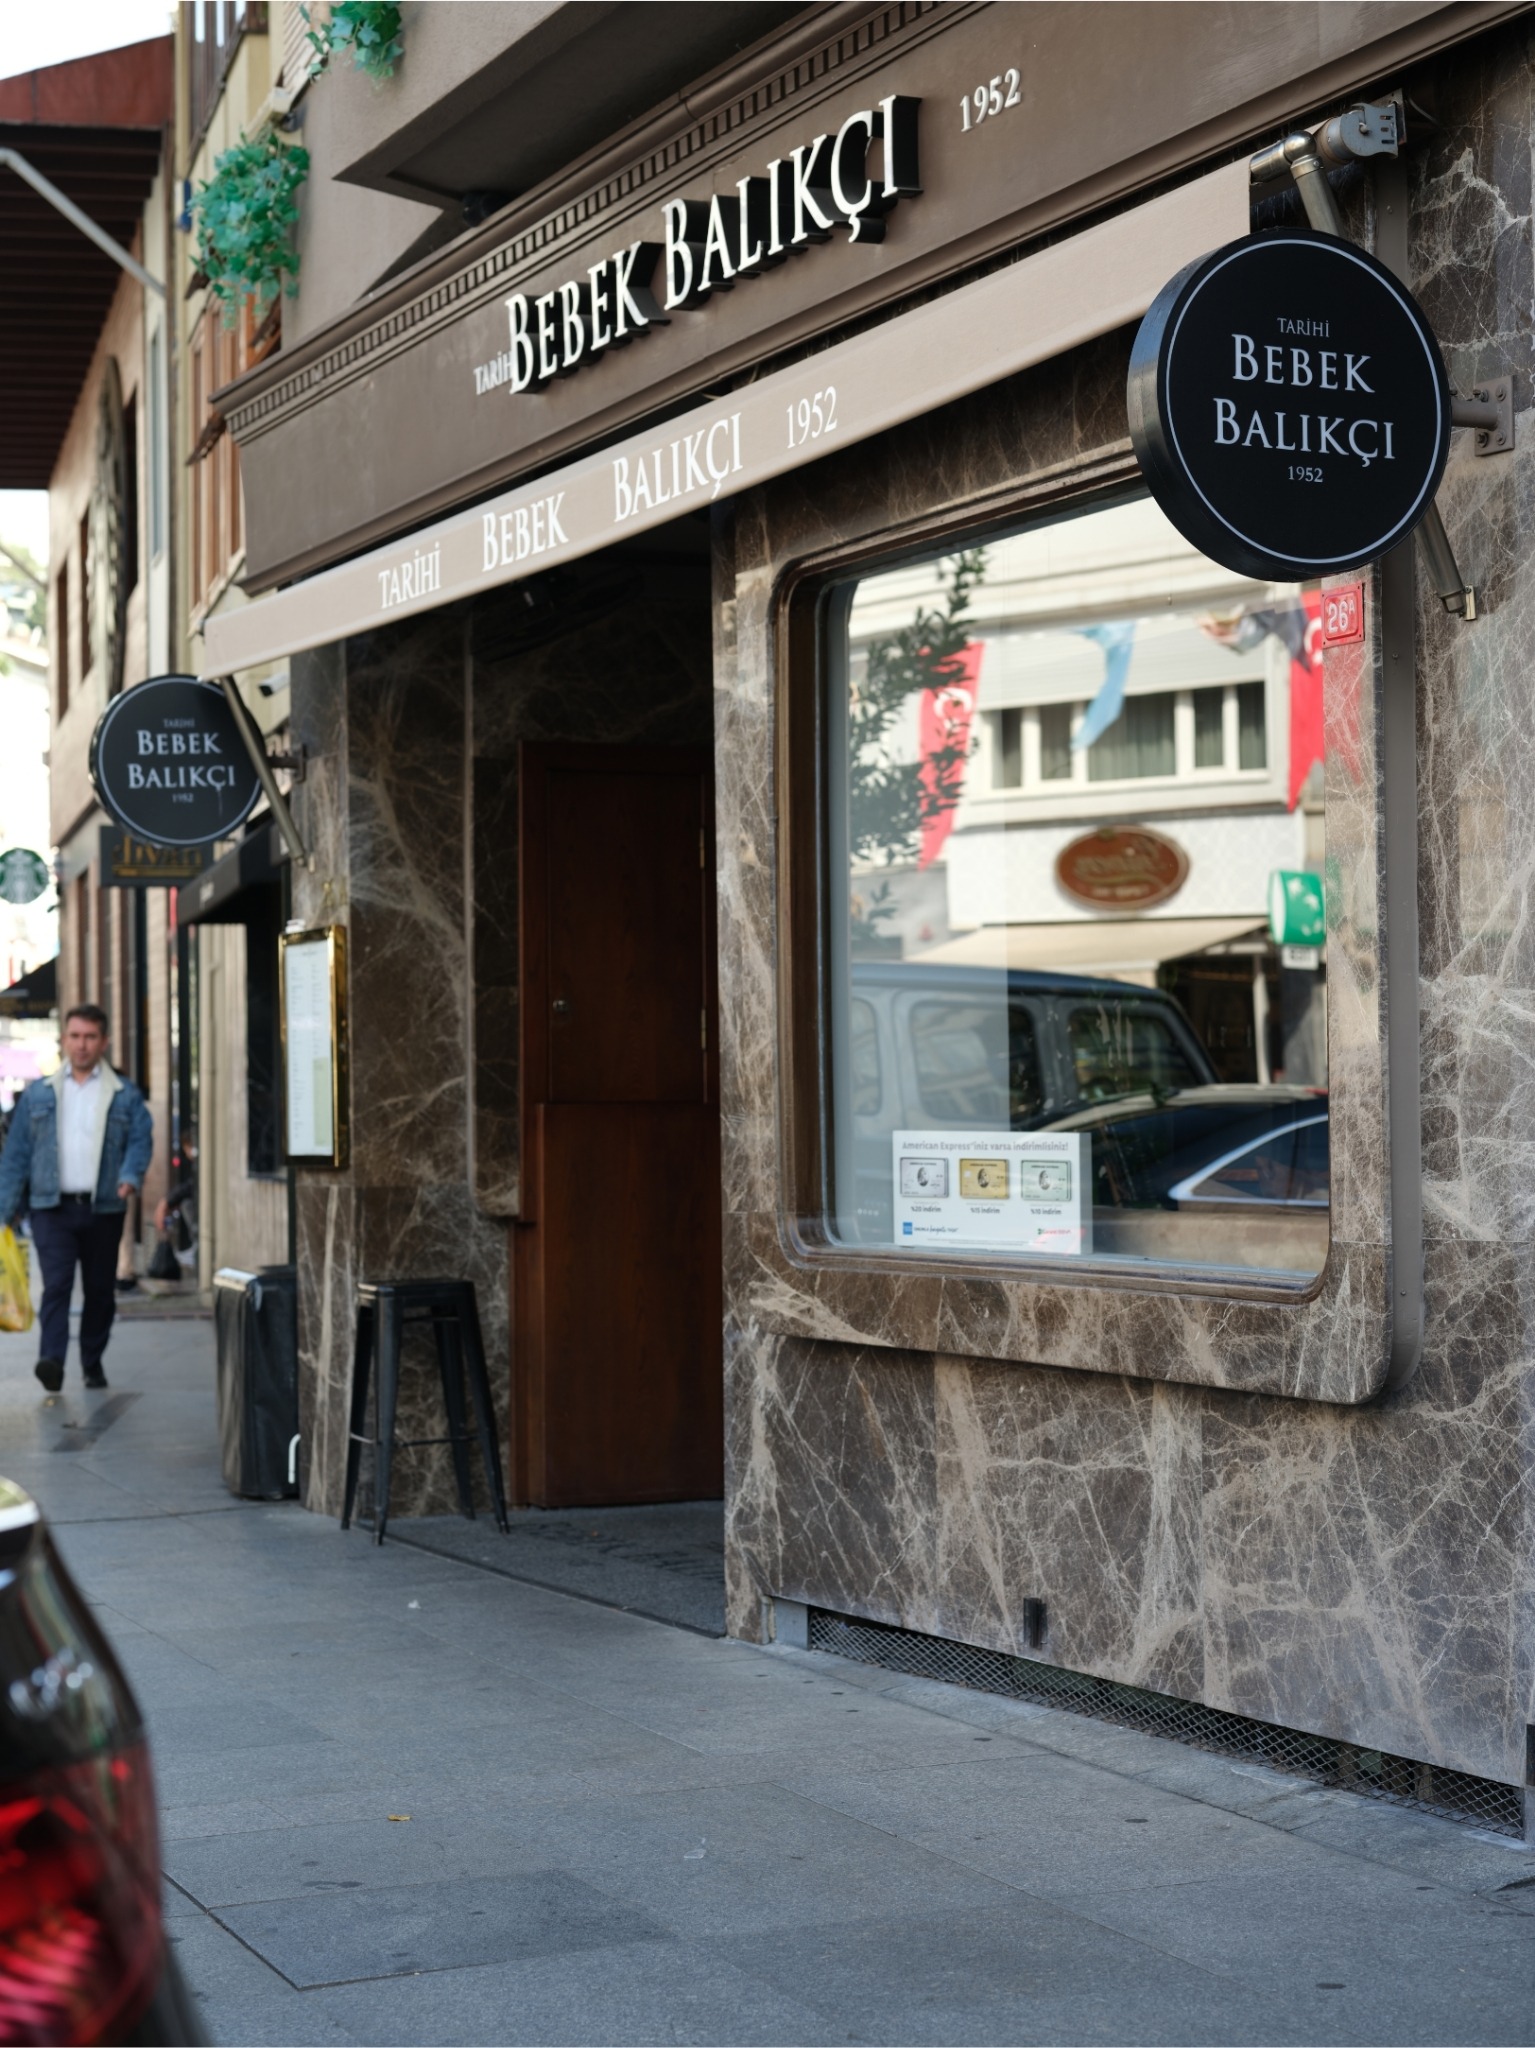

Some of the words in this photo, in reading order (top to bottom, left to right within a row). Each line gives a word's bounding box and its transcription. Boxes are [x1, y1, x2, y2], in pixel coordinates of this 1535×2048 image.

[473, 350, 514, 395] TARİH
[505, 240, 648, 394] BEBEK
[661, 94, 899, 310] BALIKÇI
[959, 68, 1021, 132] 1952
[1277, 317, 1330, 338] TARİHİ
[1231, 333, 1375, 393] BEBEK
[1213, 397, 1396, 468] BALIKÇI
[1287, 465, 1324, 483] 1952
[378, 541, 441, 610] TARİHİ
[482, 491, 569, 572] BEBEK
[612, 412, 744, 523] BALIKÇI
[786, 386, 838, 449] 1952
[137, 729, 222, 756] BEBEK
[127, 763, 236, 793] BALIKÇI
[901, 1140, 939, 1150] American
[990, 1143, 1012, 1151] varsa
